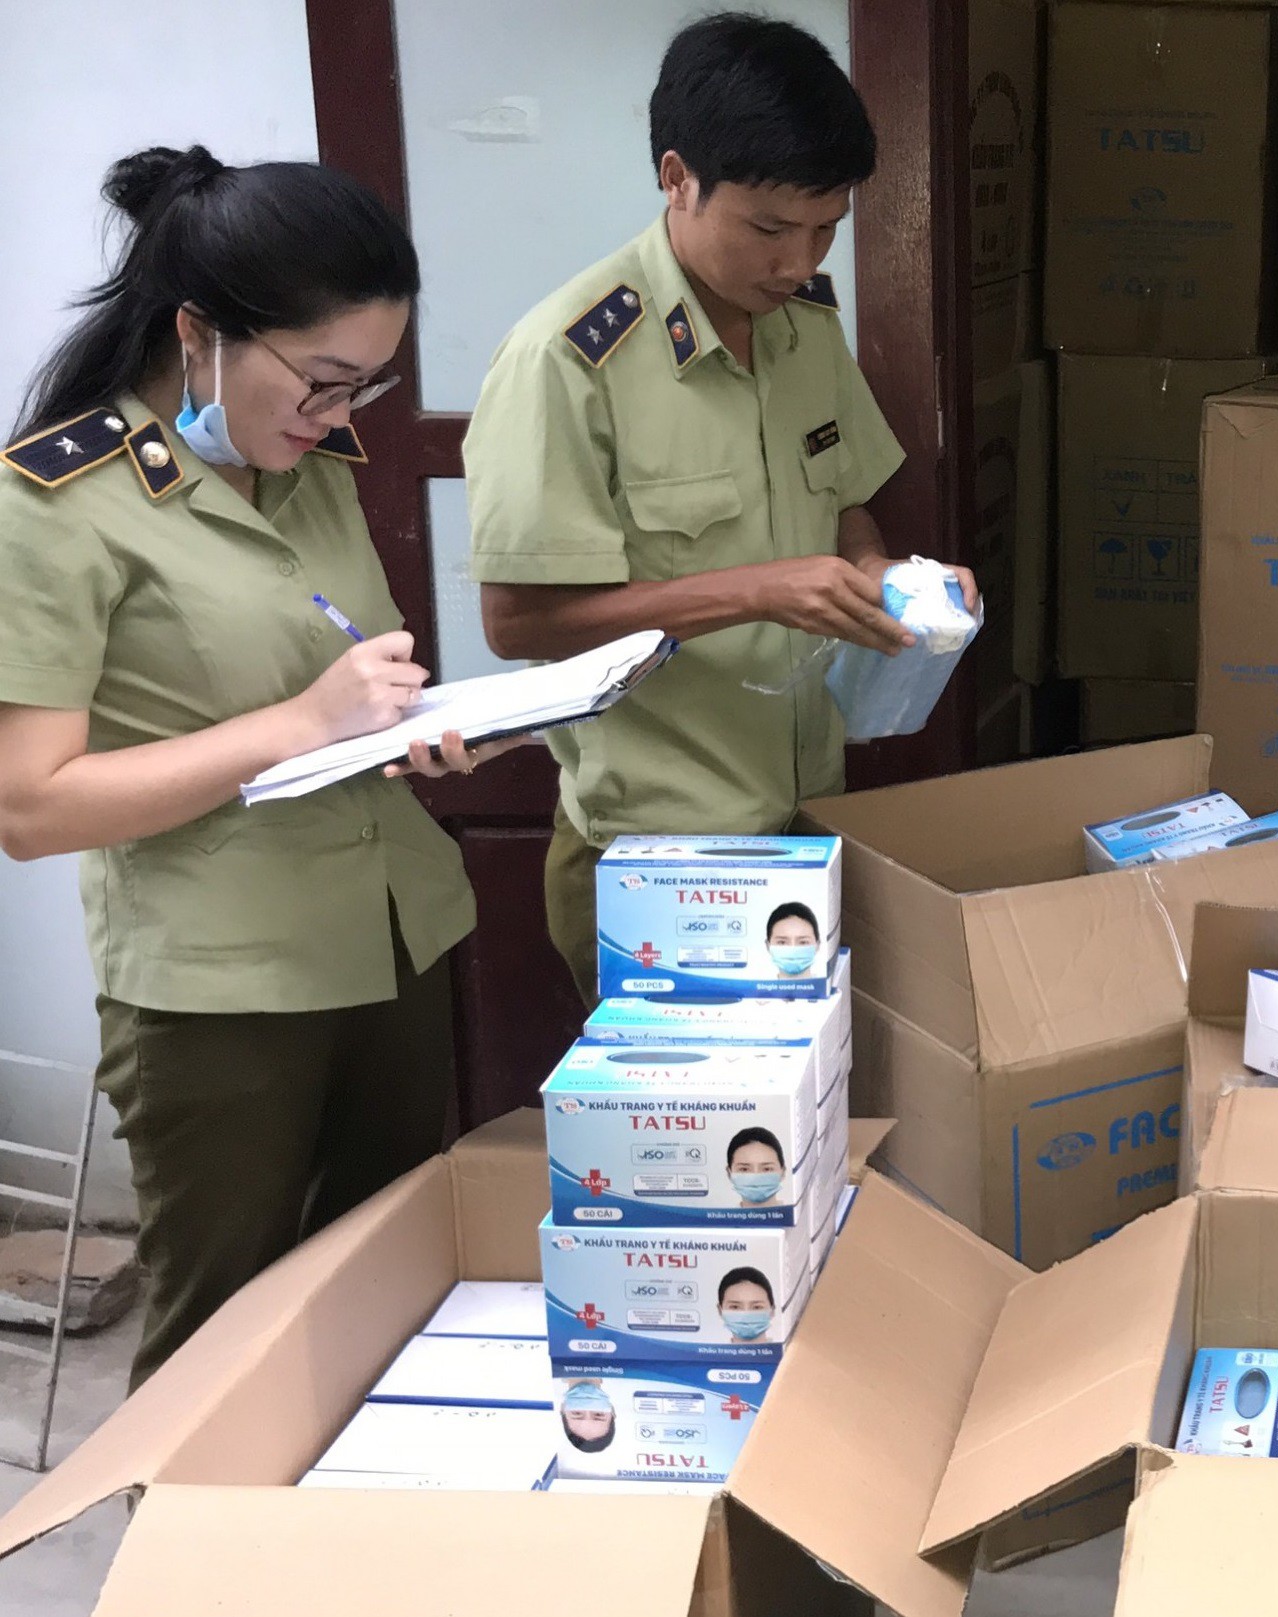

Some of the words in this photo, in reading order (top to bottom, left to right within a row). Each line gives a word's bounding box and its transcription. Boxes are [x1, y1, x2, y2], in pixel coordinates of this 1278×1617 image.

[1099, 127, 1206, 154] TATSU
[710, 878, 768, 886] RESISTANCE
[676, 890, 747, 904] TATSU
[621, 1103, 655, 1111] TRANG
[666, 1100, 678, 1111] TẾ
[680, 1101, 717, 1111] KHÁNG
[629, 1115, 706, 1131] TATSU
[1109, 1103, 1181, 1155] FAC
[615, 1240, 648, 1249] TRANG
[651, 1241, 657, 1249] Y
[659, 1238, 671, 1249] TẾ
[673, 1240, 708, 1250] KHÁNG
[623, 1253, 698, 1268] TATSU
[719, 1372, 737, 1380] PCS
[1209, 1376, 1230, 1413] TATSU
[637, 1454, 708, 1468] TATSU
[617, 1469, 677, 1478] RESISTANCE
[678, 1471, 706, 1479] MASK
[707, 1471, 728, 1480] ACE
